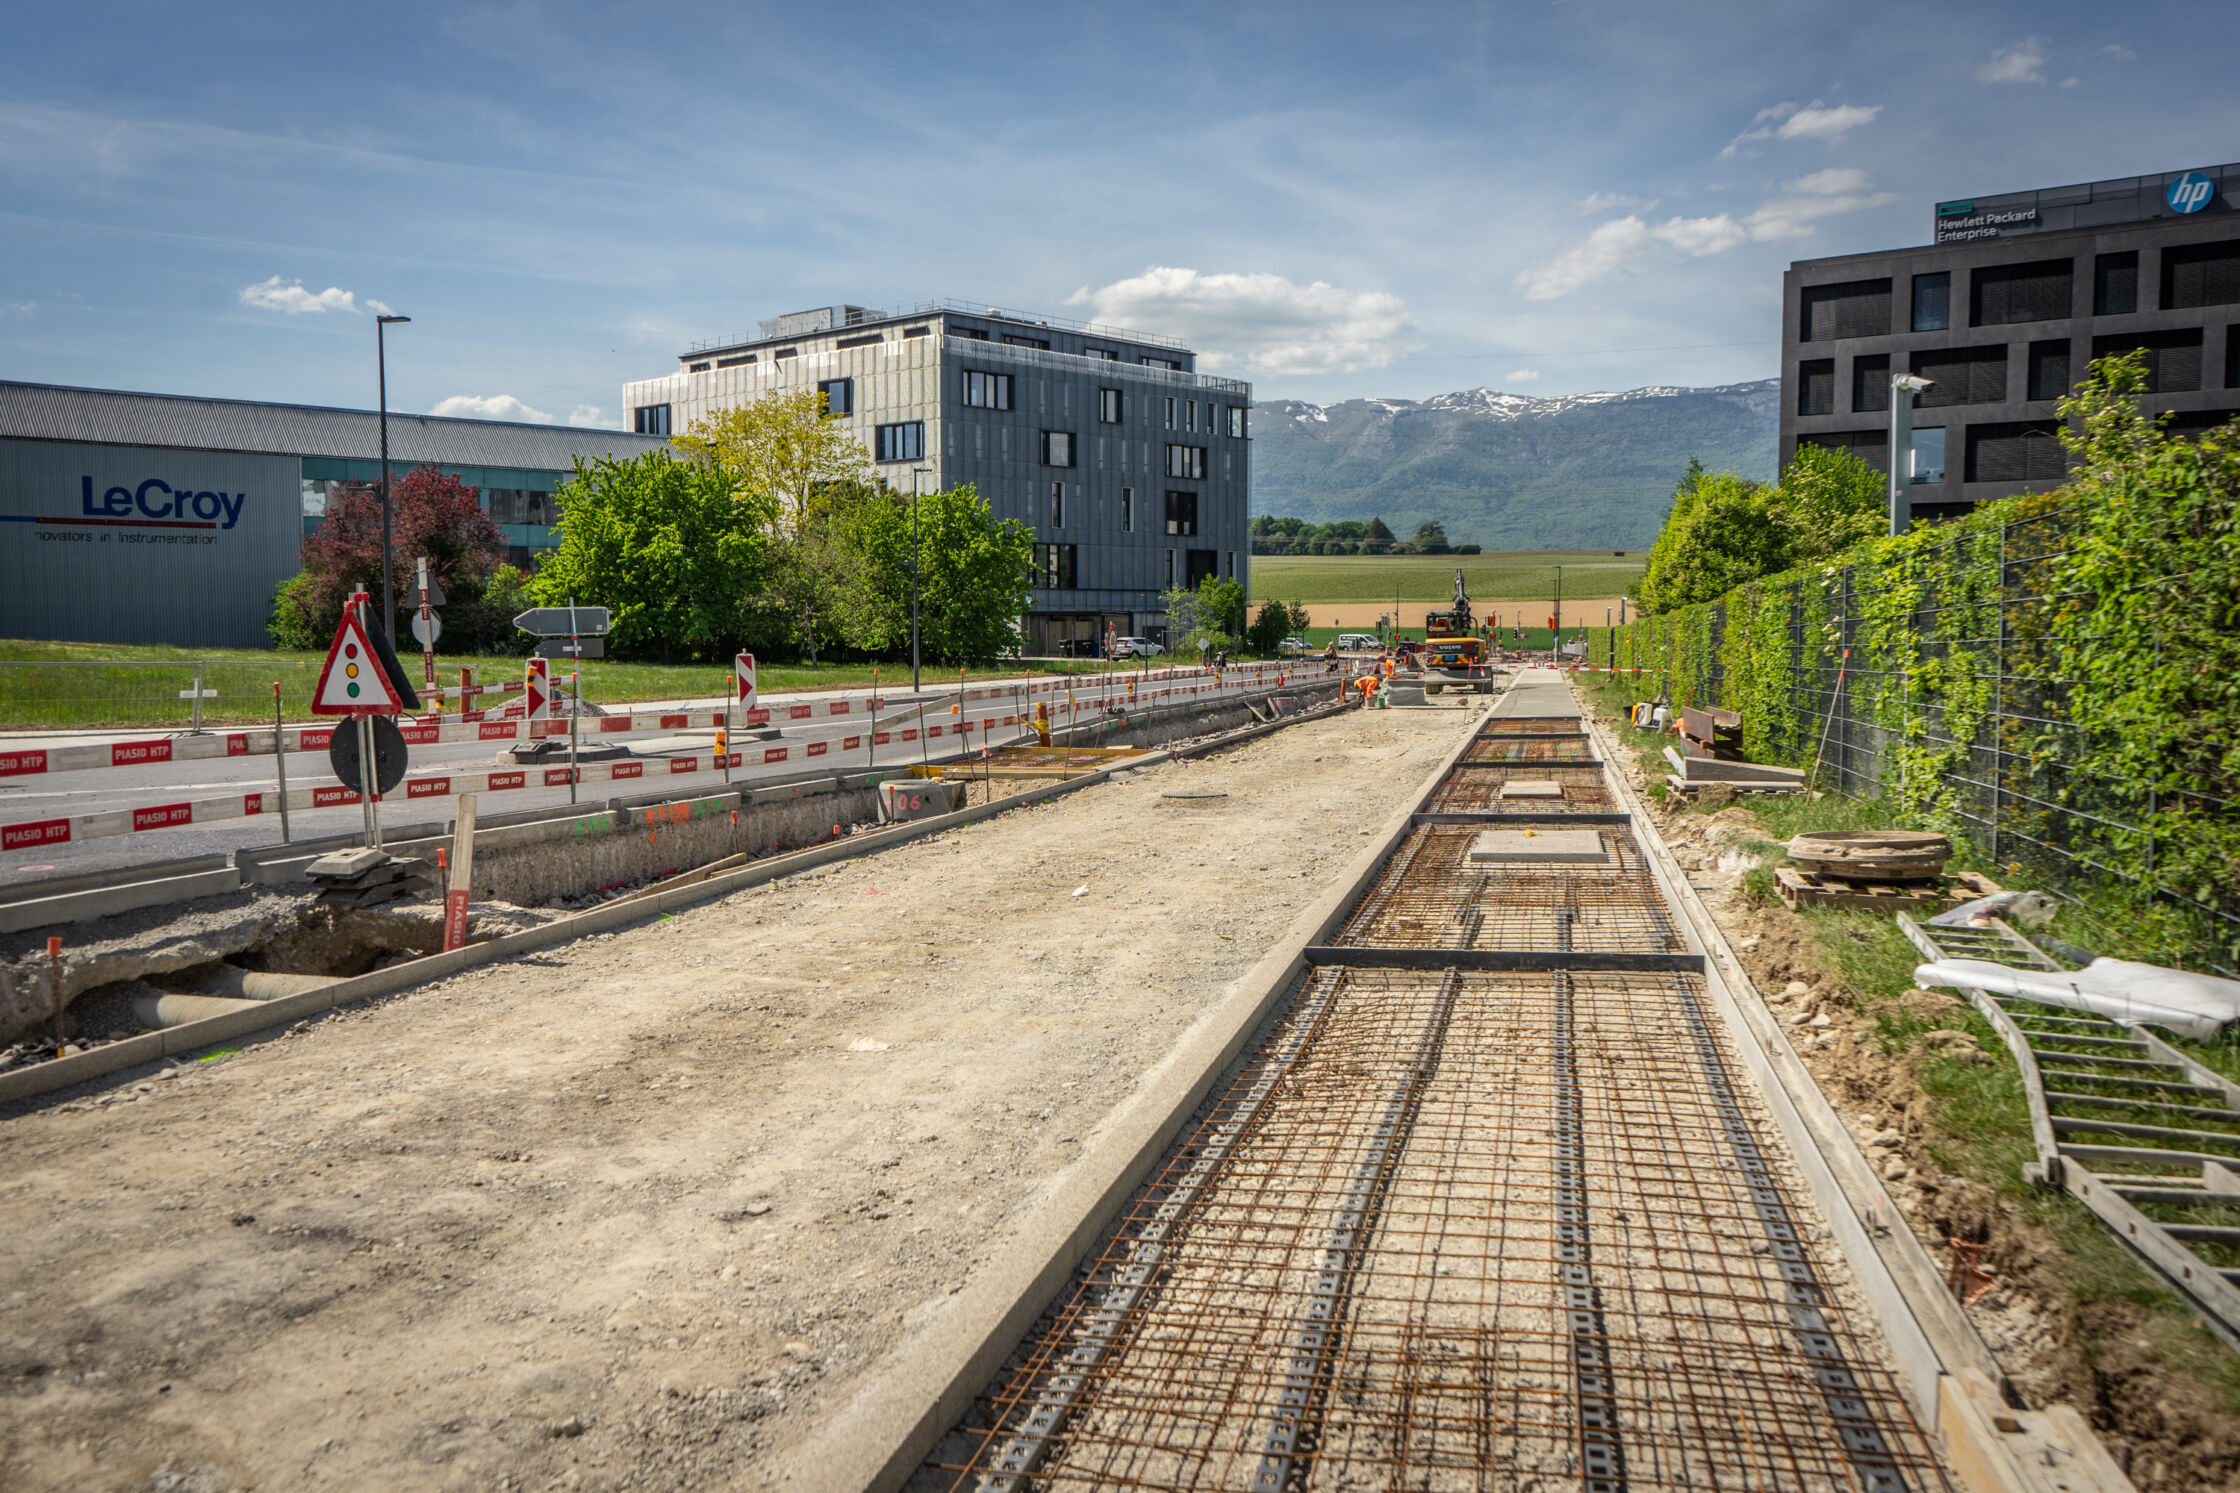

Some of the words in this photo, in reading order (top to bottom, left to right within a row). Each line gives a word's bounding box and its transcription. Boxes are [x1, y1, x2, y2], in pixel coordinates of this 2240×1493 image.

[2172, 172, 2210, 213] hp
[1938, 215, 1984, 231] Hewlett
[1986, 208, 2036, 225] Packard
[1937, 227, 1997, 242] Enterprise
[82, 476, 245, 530] LeCroy
[100, 532, 111, 542] in
[118, 532, 217, 545] Instrumentation
[424, 730, 437, 739] HTP
[480, 727, 500, 736] PIASIO
[503, 726, 516, 734] HTP
[230, 739, 245, 750] PIA
[303, 735, 329, 744] PIASIO
[115, 748, 147, 760] PIASIO
[150, 746, 169, 757] HTP
[0, 758, 17, 770] SIO
[22, 756, 43, 767] HTP
[491, 777, 509, 785] PIASIO
[511, 776, 522, 784] HTP
[550, 773, 565, 782] PIASIO
[410, 783, 431, 793] PIASIO
[434, 782, 446, 791] HTP
[316, 791, 341, 802] PIASIO
[344, 790, 358, 800] HTP
[136, 812, 167, 825] PIASIO
[171, 808, 188, 820] HTP
[5, 829, 42, 843] PIASIO
[46, 825, 67, 838] HTP
[453, 896, 465, 945] PIASIO
